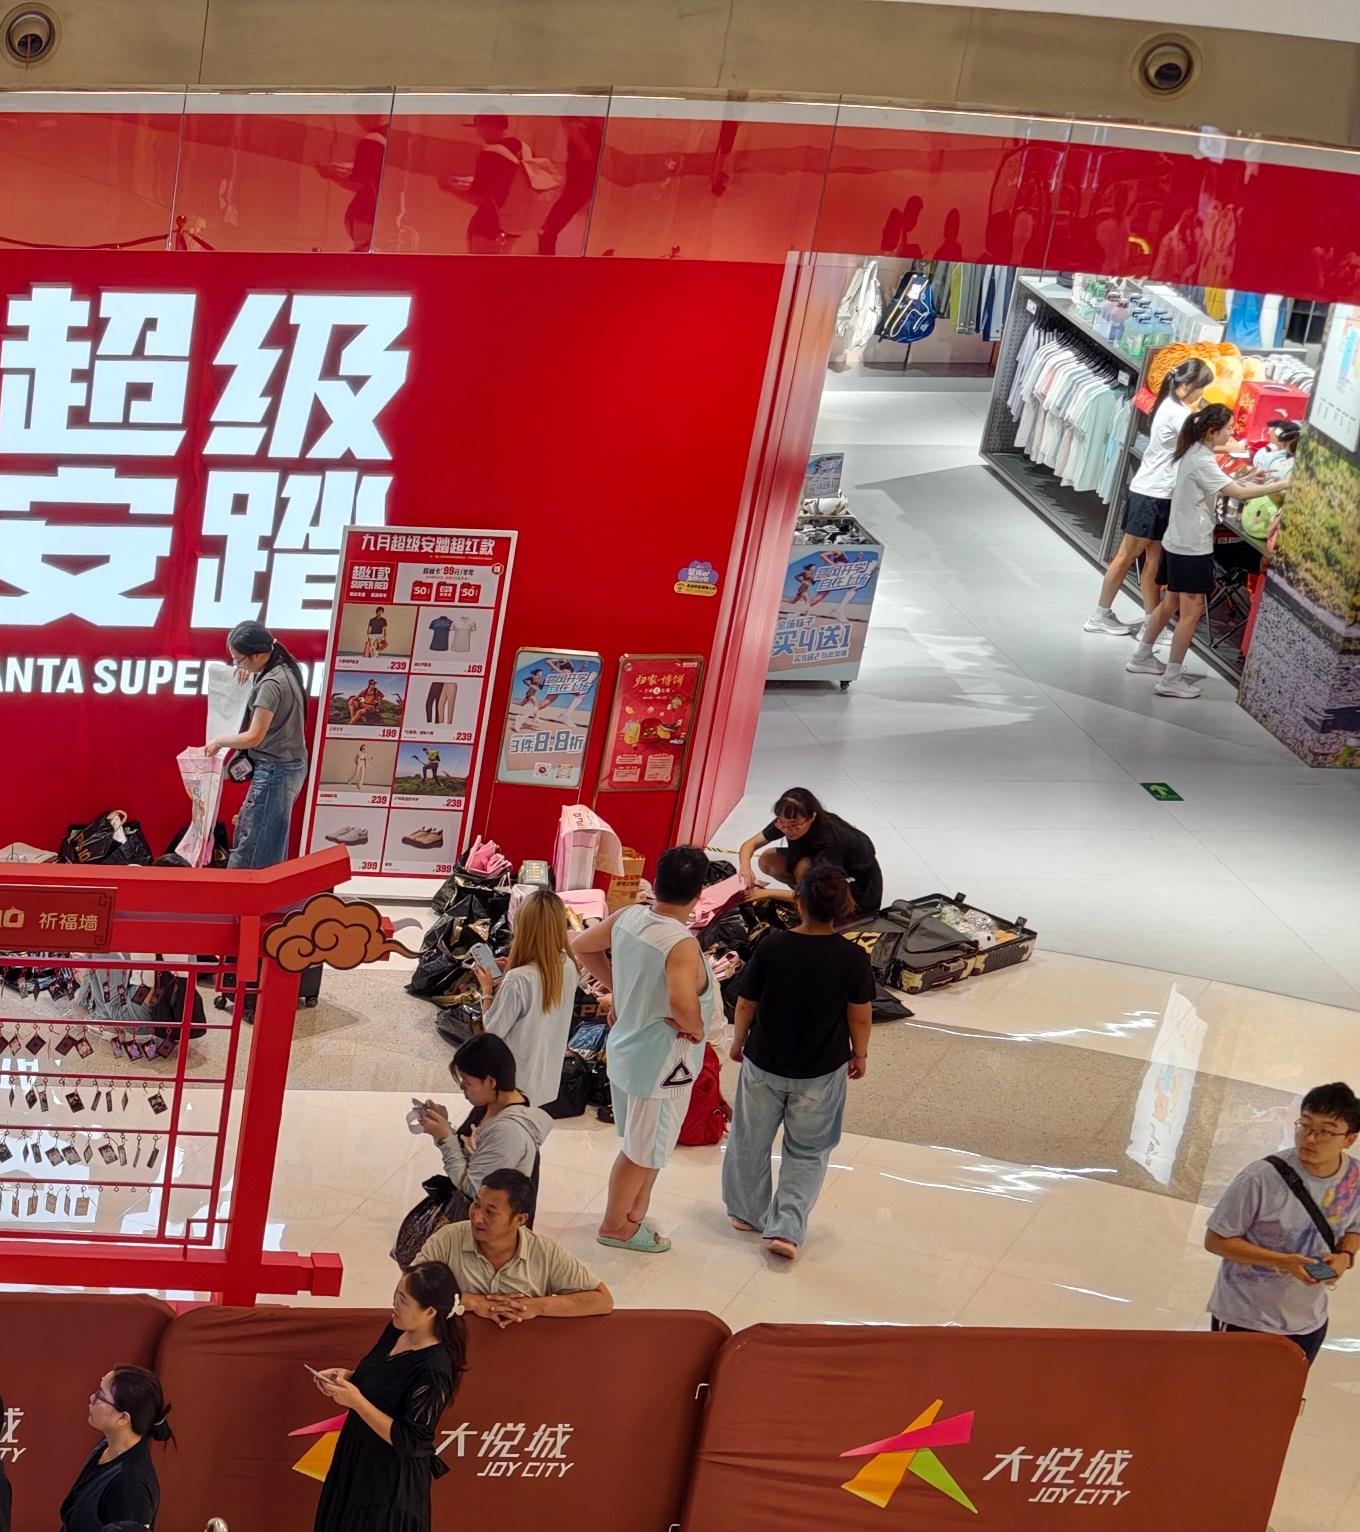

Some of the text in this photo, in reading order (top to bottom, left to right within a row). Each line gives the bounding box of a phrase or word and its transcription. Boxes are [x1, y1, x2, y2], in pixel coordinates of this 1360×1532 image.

[361, 533, 496, 556] 九月超级安踏超红款
[350, 581, 389, 590] SUPER RED
[92, 658, 225, 696] SUPE
[510, 731, 584, 753] 3件8.8折
[38, 912, 99, 934] 祈福墙
[435, 1422, 574, 1461] 大悦城
[477, 1461, 574, 1479] JOY CITY
[983, 1446, 1133, 1487] 大悦城
[1029, 1488, 1131, 1506] JOY CITY
